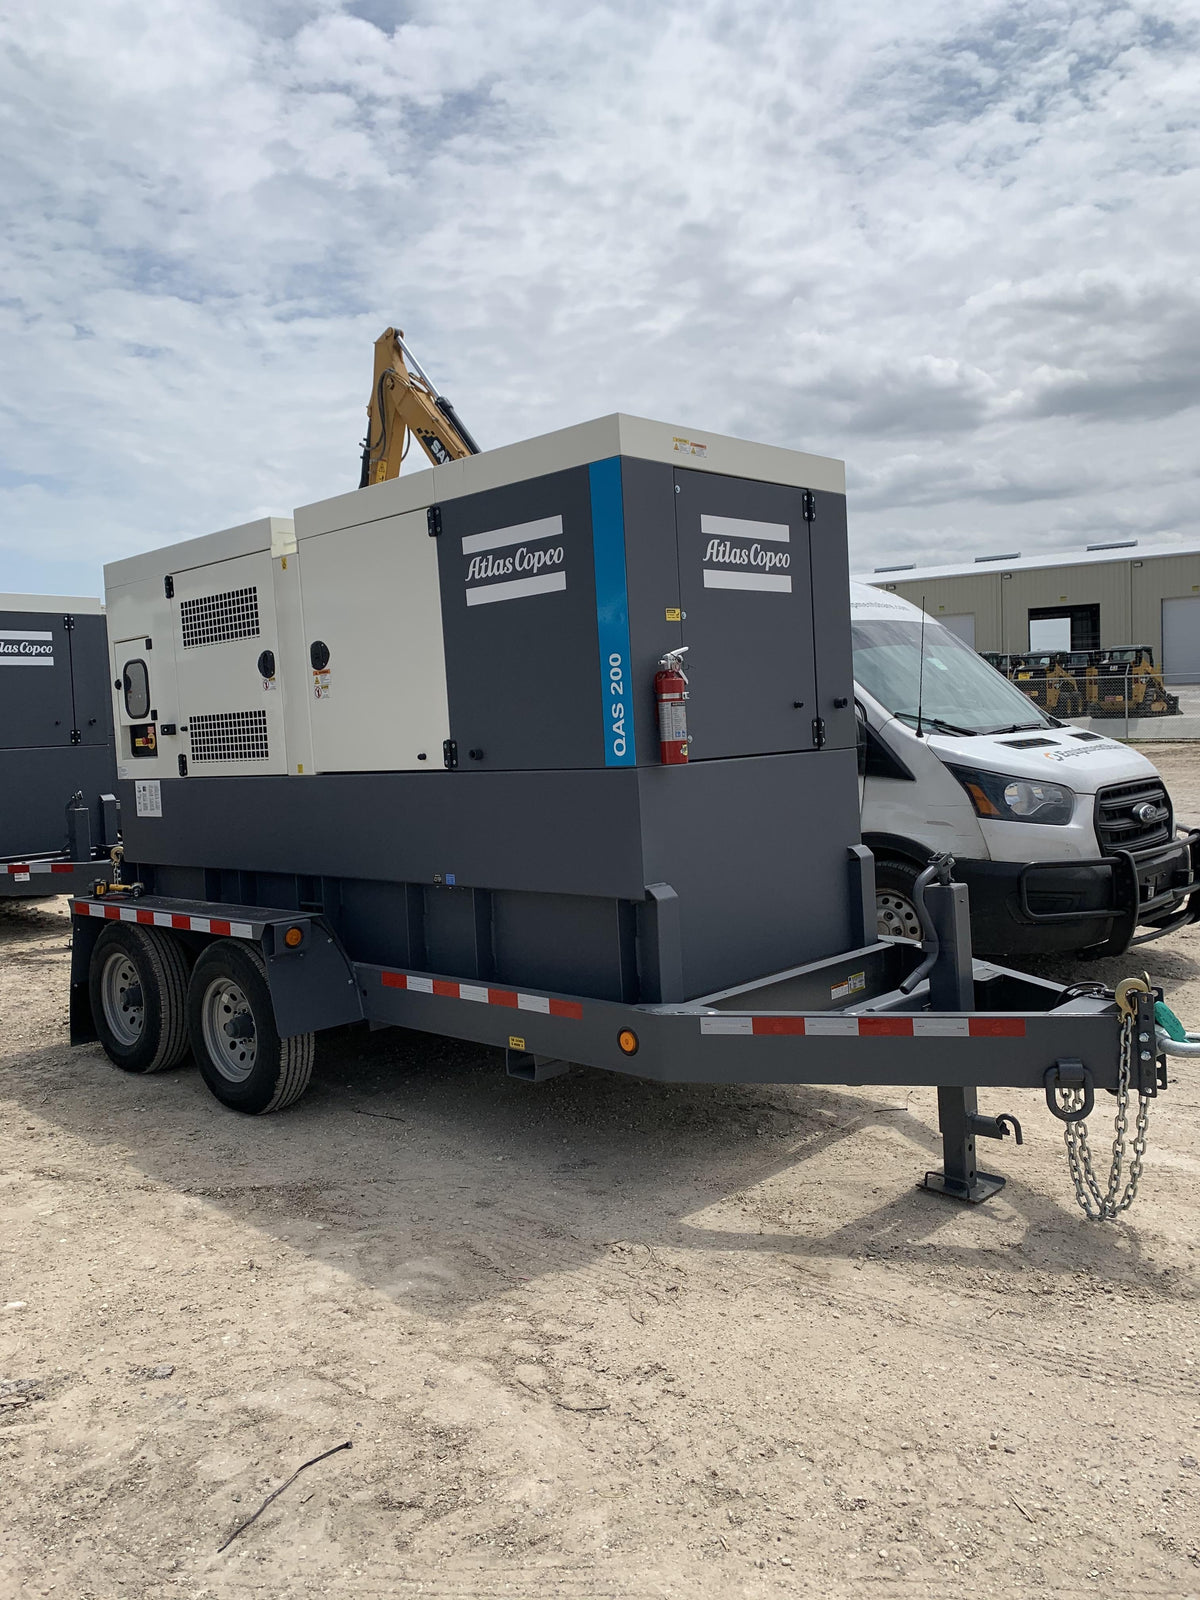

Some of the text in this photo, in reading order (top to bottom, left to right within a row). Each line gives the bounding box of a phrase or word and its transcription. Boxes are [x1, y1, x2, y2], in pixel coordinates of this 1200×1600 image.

[465, 547, 564, 582] Atlas Copco
[703, 539, 790, 571] Atlas Copco
[0, 641, 53, 656] las Copco
[608, 653, 627, 757] QAS 200
